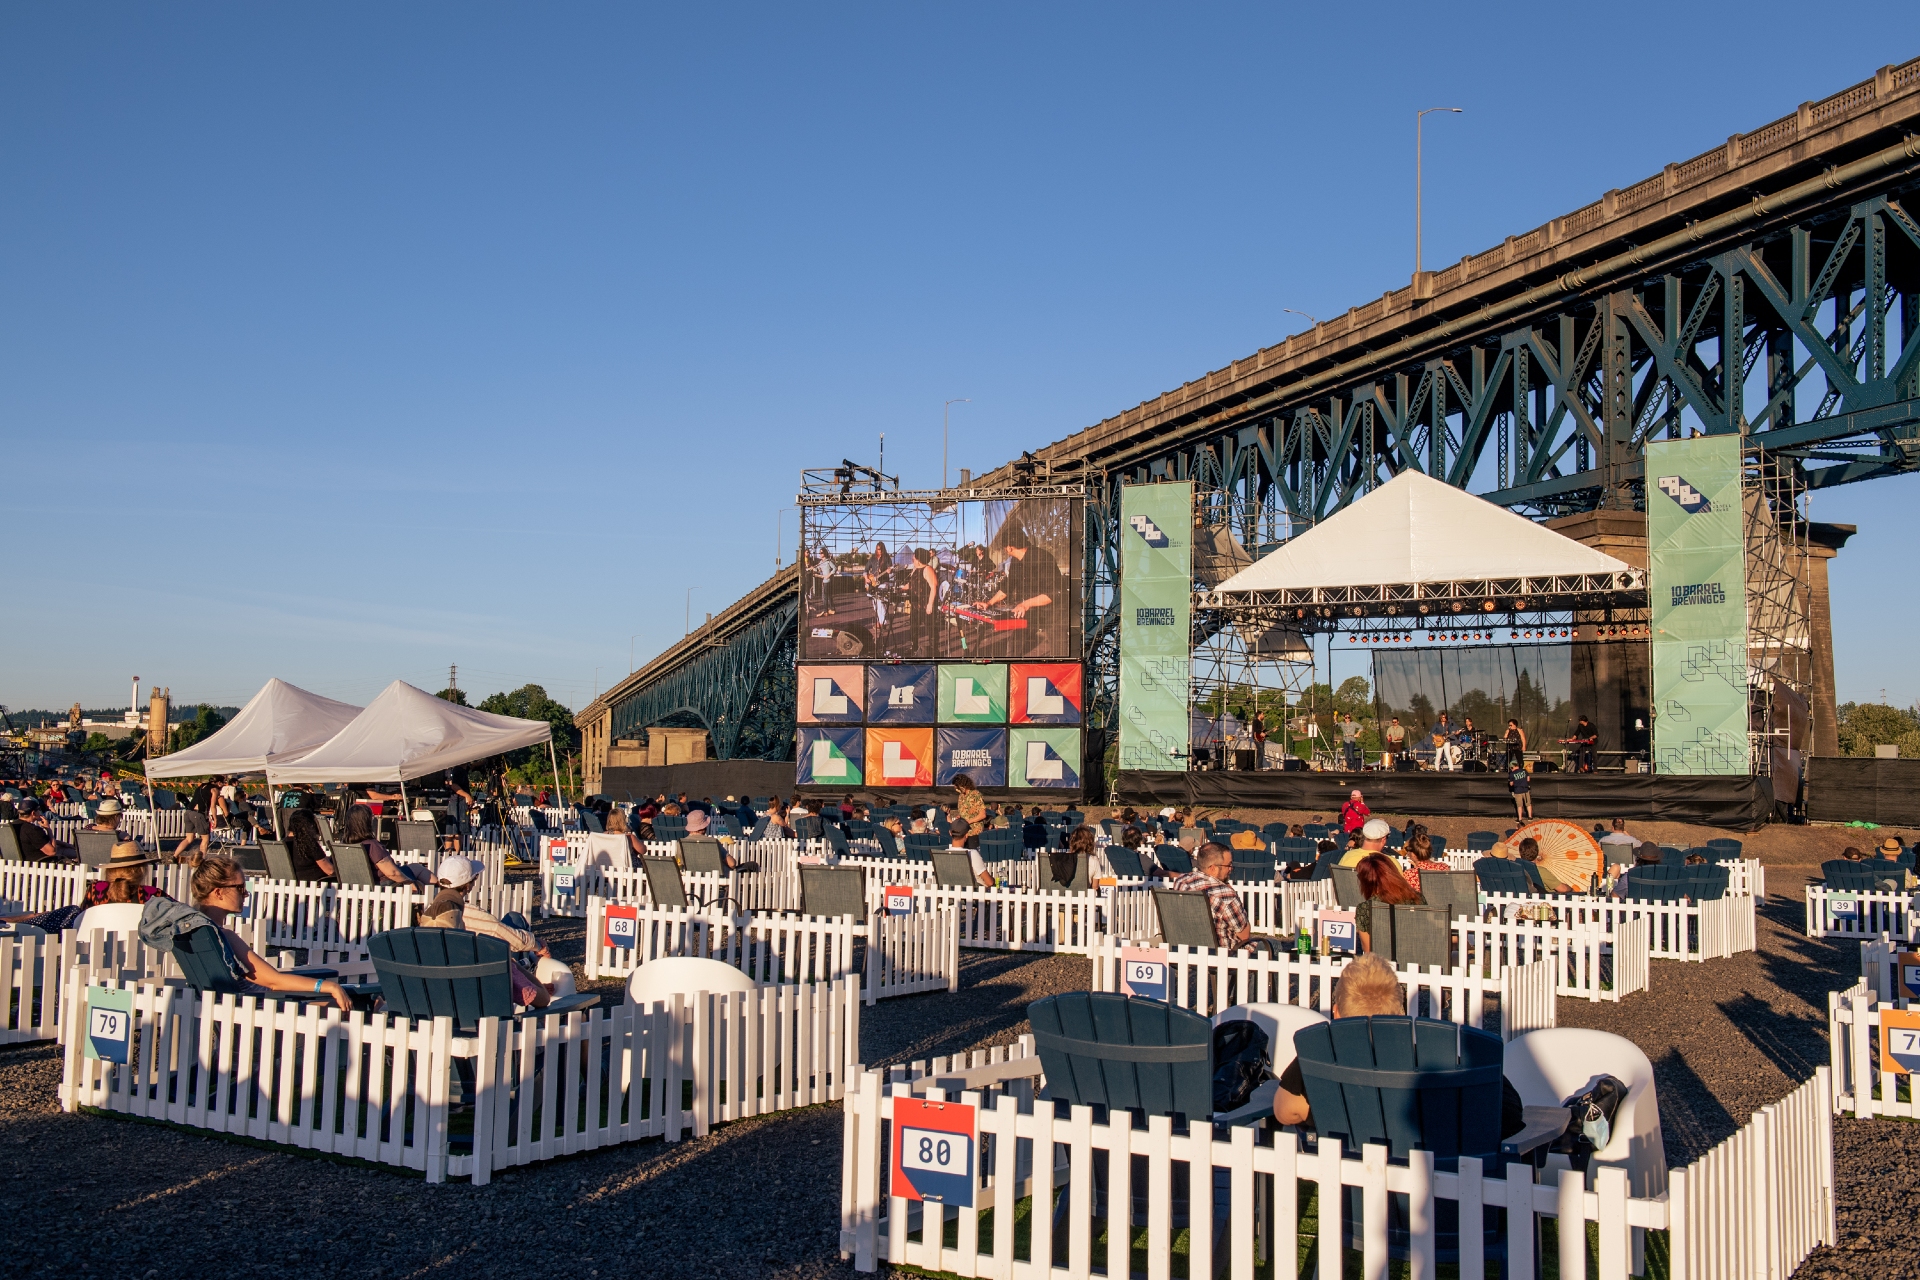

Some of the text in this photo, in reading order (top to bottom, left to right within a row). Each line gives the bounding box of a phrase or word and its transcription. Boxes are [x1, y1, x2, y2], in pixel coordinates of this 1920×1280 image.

[560, 876, 569, 885] 55
[893, 898, 905, 907] 56
[1837, 902, 1849, 910] 39
[615, 921, 628, 932] 68
[1330, 924, 1344, 934] 57
[1136, 966, 1154, 979] 69
[100, 1014, 117, 1034] 79
[1903, 1033, 1920, 1051] 7
[919, 1137, 951, 1166] 80
